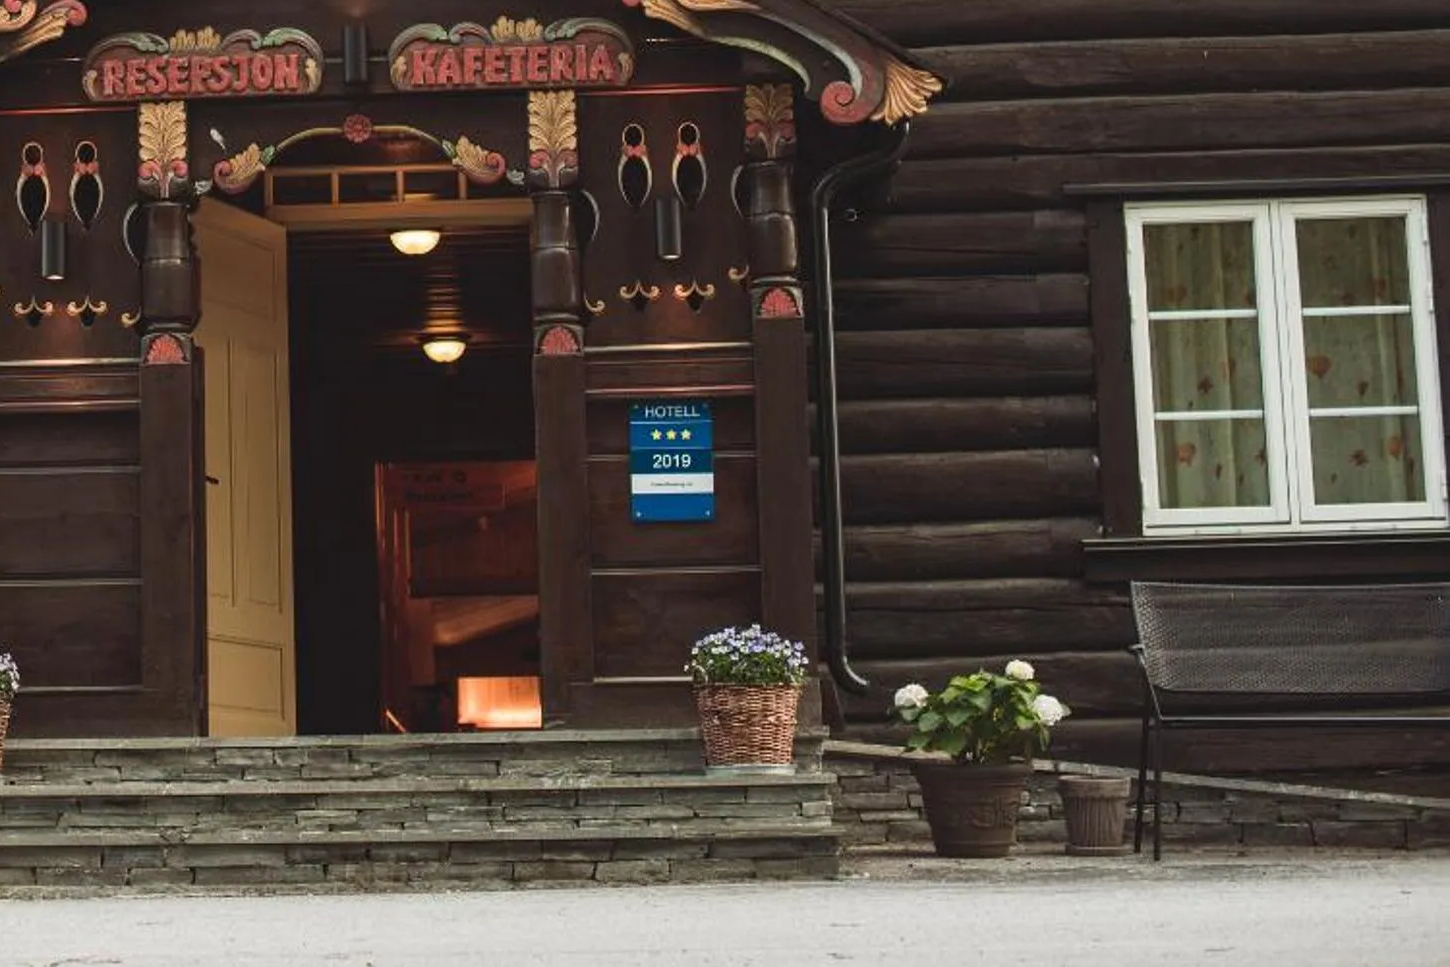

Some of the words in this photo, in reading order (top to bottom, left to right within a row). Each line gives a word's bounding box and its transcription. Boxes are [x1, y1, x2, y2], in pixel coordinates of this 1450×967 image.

[102, 52, 301, 96] RESEPSJON
[410, 43, 615, 86] KAFETERIA
[644, 405, 701, 418] HOTELL
[652, 454, 692, 469] 2019
